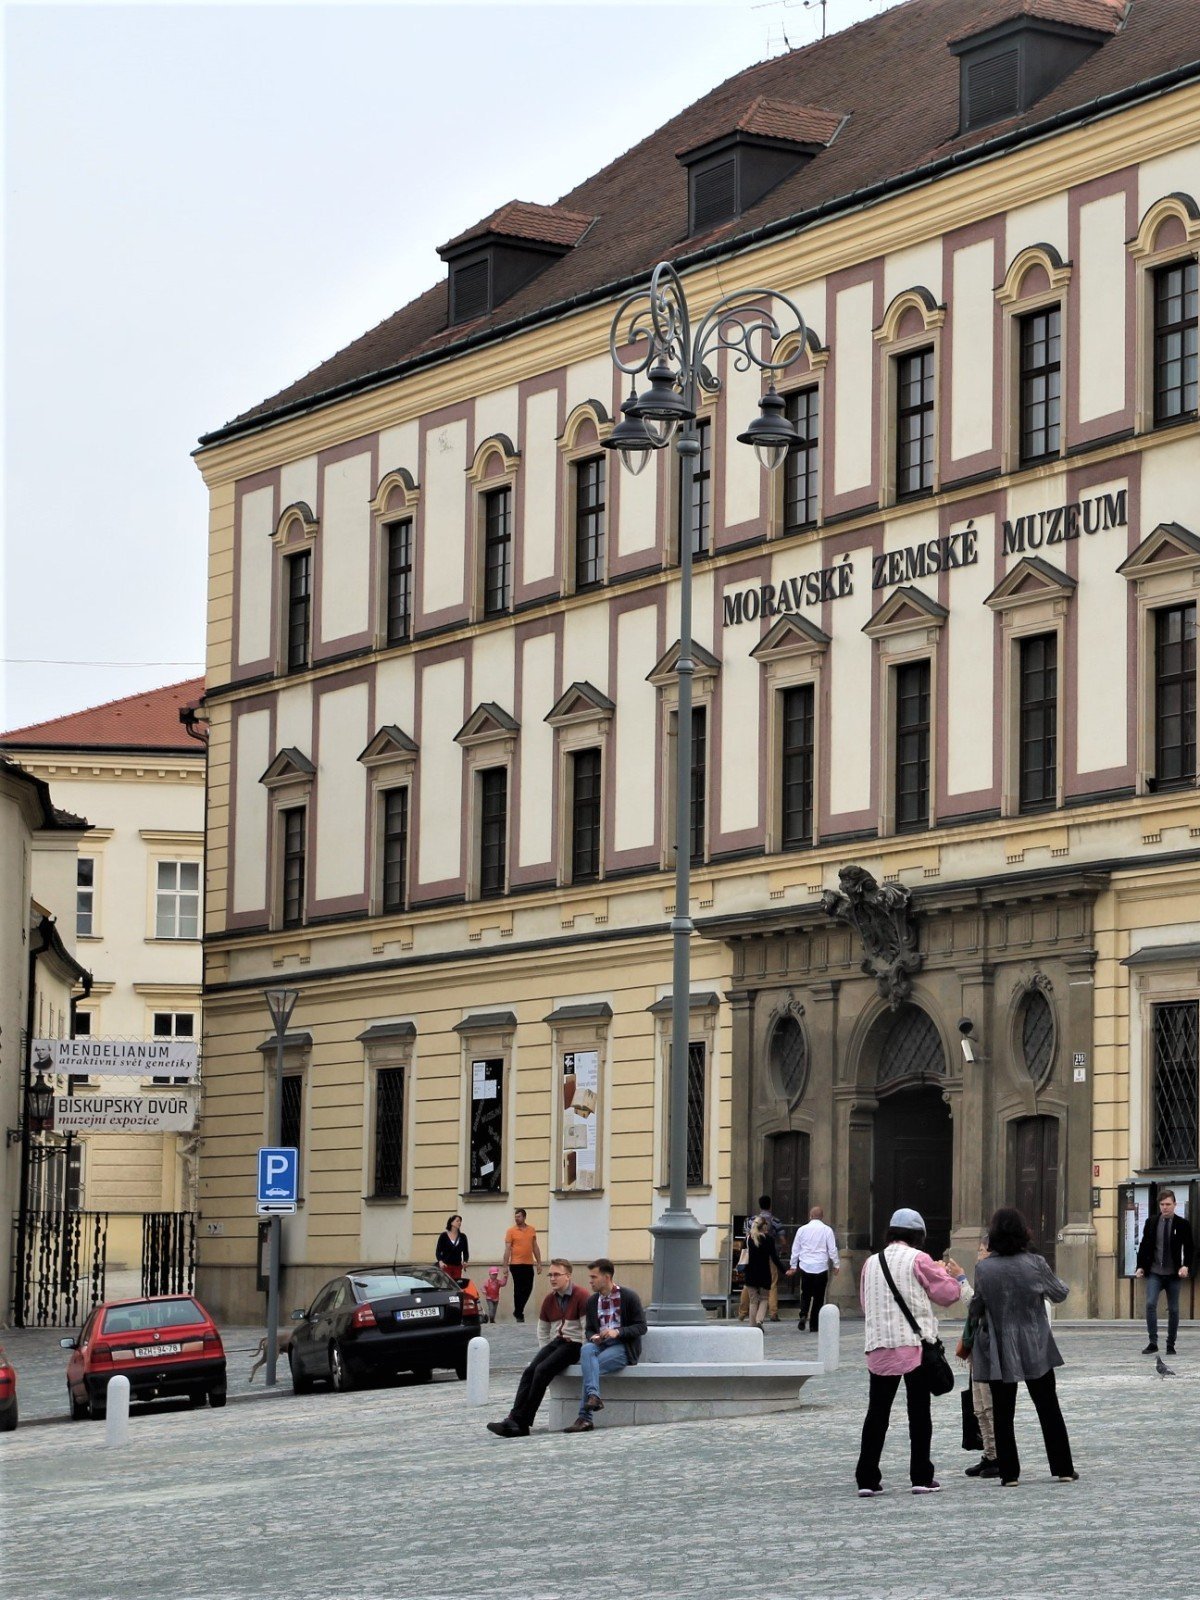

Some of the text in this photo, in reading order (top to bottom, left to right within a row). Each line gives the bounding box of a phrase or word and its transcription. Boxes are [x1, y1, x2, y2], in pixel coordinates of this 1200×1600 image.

[723, 489, 1128, 627] MORAVSKÉ ZEMSKÉ MUZEUM
[59, 1043, 169, 1058] MENDELIANUM
[58, 1056, 193, 1069] atraktivní svět genetiky
[58, 1098, 188, 1114] BISKUPSKÝ DVŮR
[58, 1114, 160, 1128] muzejní expozice
[266, 1155, 289, 1185] P
